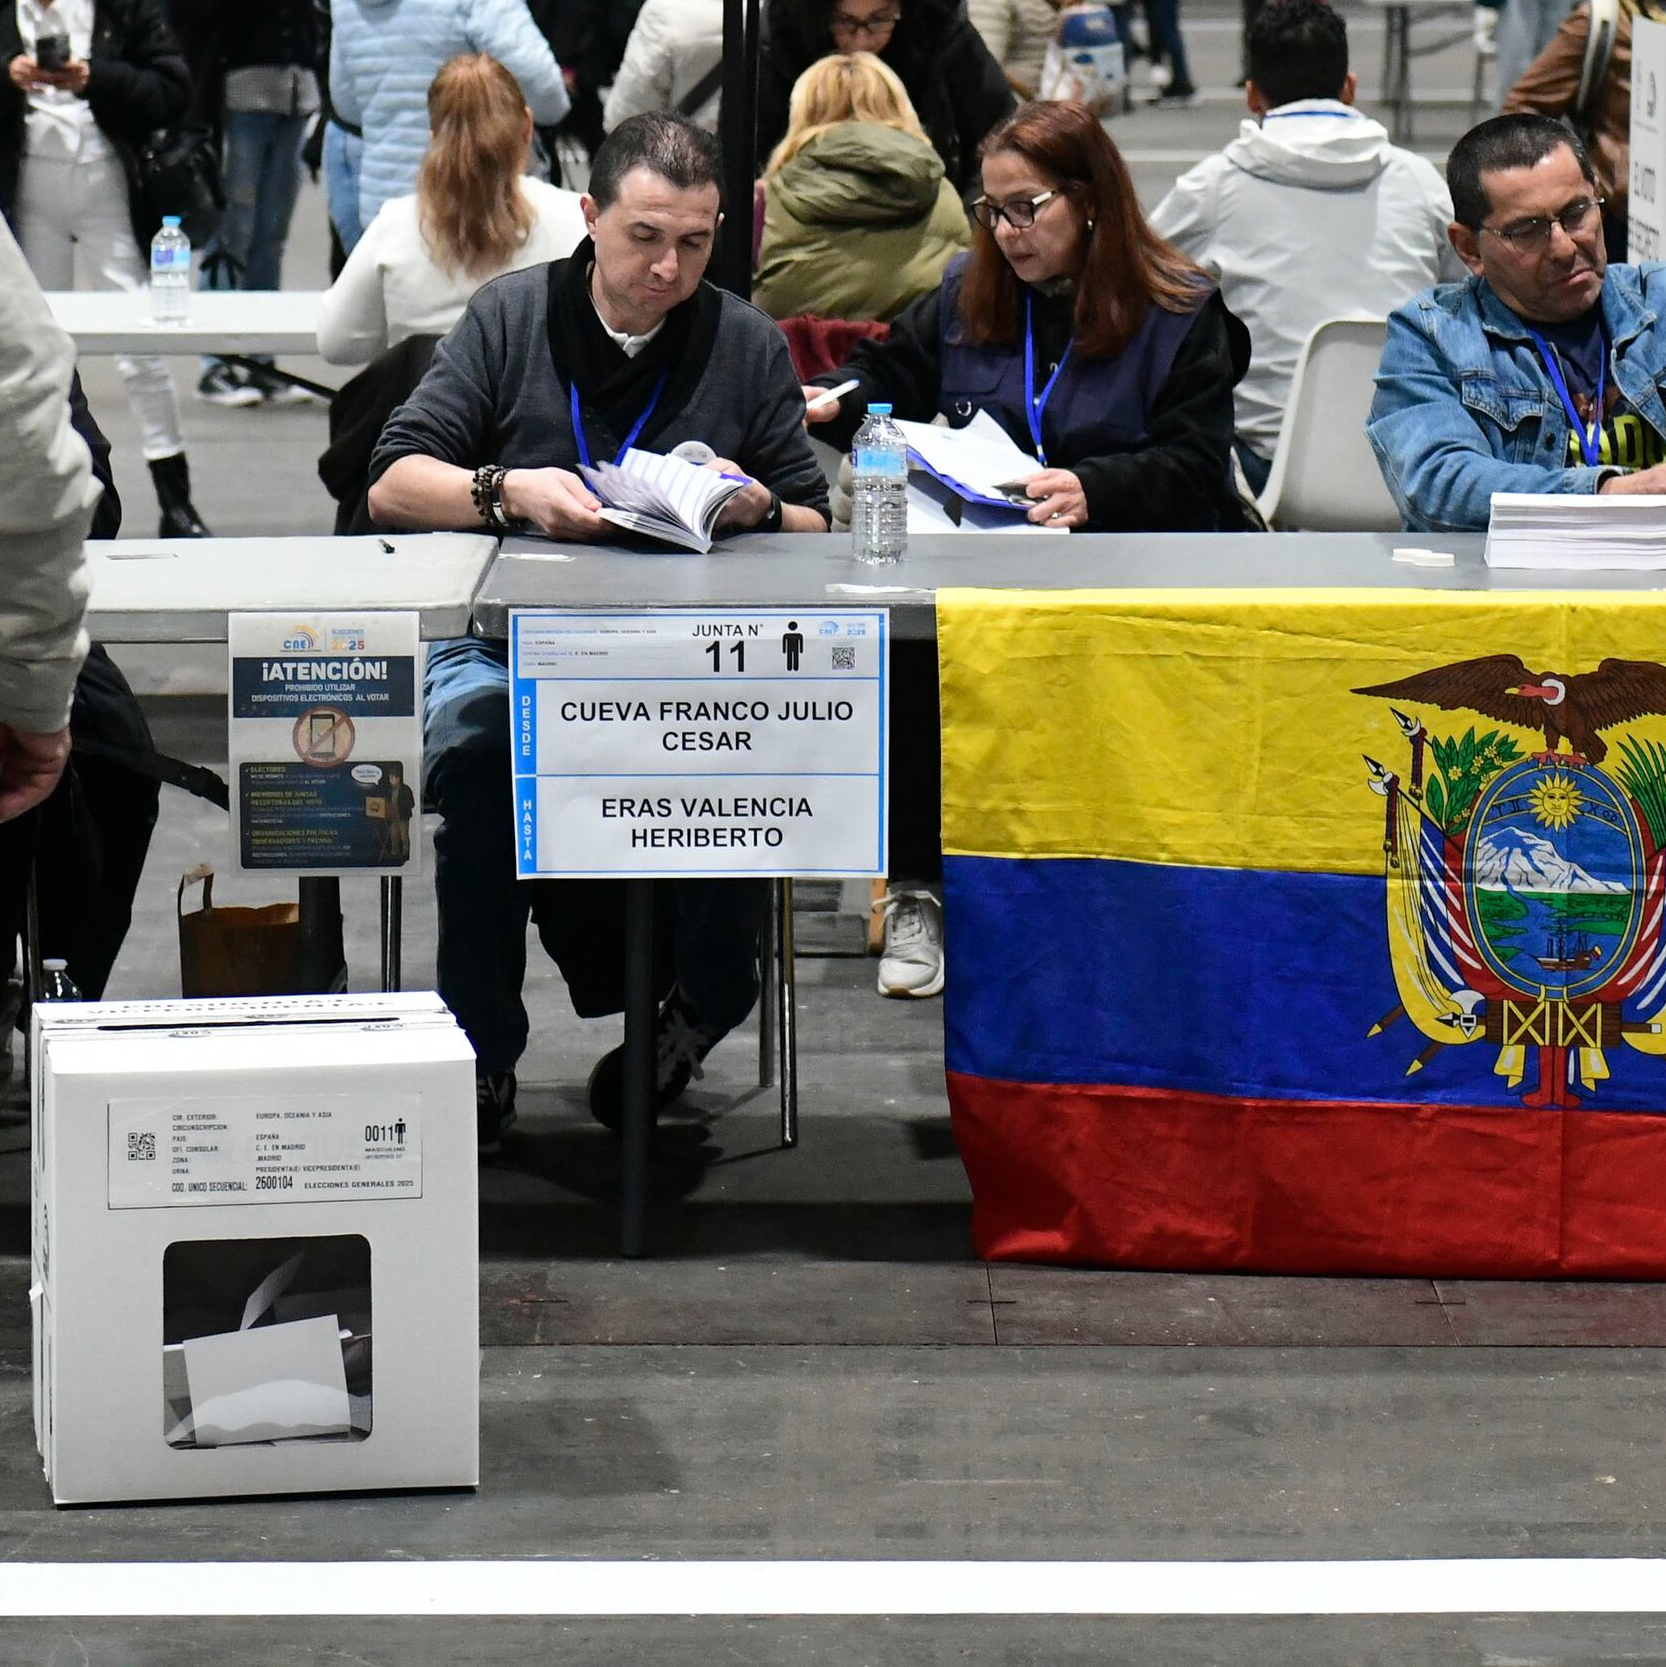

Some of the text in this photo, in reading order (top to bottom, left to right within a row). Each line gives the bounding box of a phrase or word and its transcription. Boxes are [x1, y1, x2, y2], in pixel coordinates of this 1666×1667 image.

[693, 624, 744, 637] JUNTA
[706, 640, 745, 672] 11
[262, 658, 388, 682] ¡ATENCIÓN!
[251, 695, 299, 703] DISPOSITIVOS
[300, 692, 353, 702] ELECTRÓNICOS
[366, 693, 389, 702] VOTAR
[285, 684, 356, 692] PROHIBIDO UTILIZAR
[561, 701, 854, 721] CUEVA FRANCO JULIO
[522, 696, 532, 756] DESDE
[663, 731, 753, 751] CESAR
[602, 797, 814, 817] ERAS VALENCIA
[523, 800, 533, 860] HASTA
[632, 828, 784, 848] HERIBERTO
[365, 1125, 393, 1142] 0011
[303, 1164, 361, 1172] VICEPRESIDENTA(E)
[255, 1176, 293, 1190] 2600104
[304, 1181, 349, 1189] ELECCIONES
